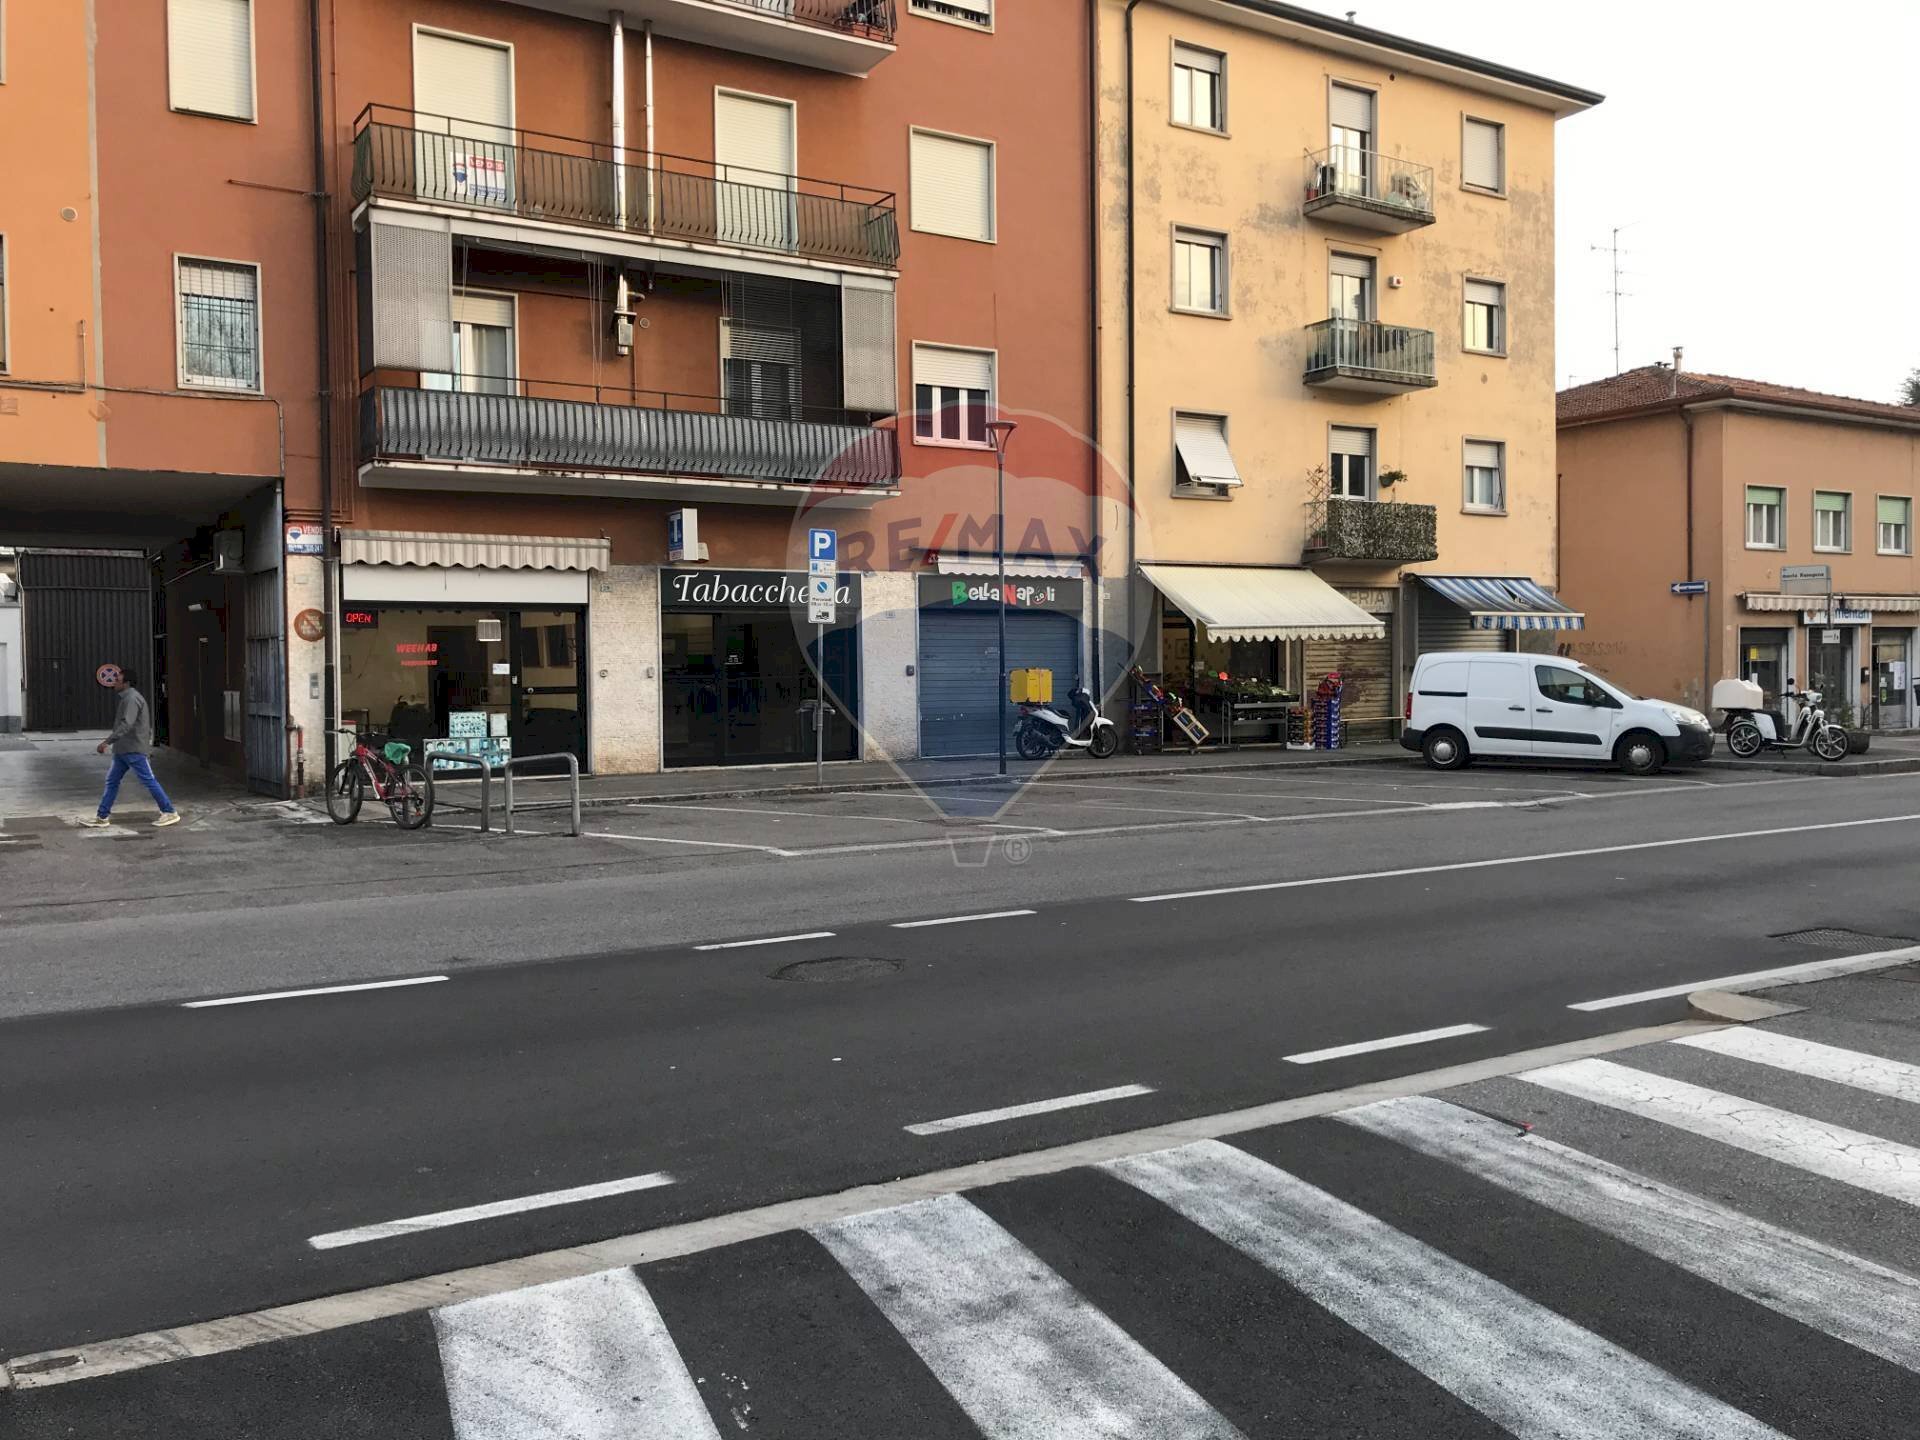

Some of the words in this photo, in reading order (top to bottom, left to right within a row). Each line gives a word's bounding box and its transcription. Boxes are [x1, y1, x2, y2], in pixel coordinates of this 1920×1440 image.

[814, 531, 832, 557] P
[672, 572, 851, 605] Tabacchea
[345, 613, 373, 623] OPEN
